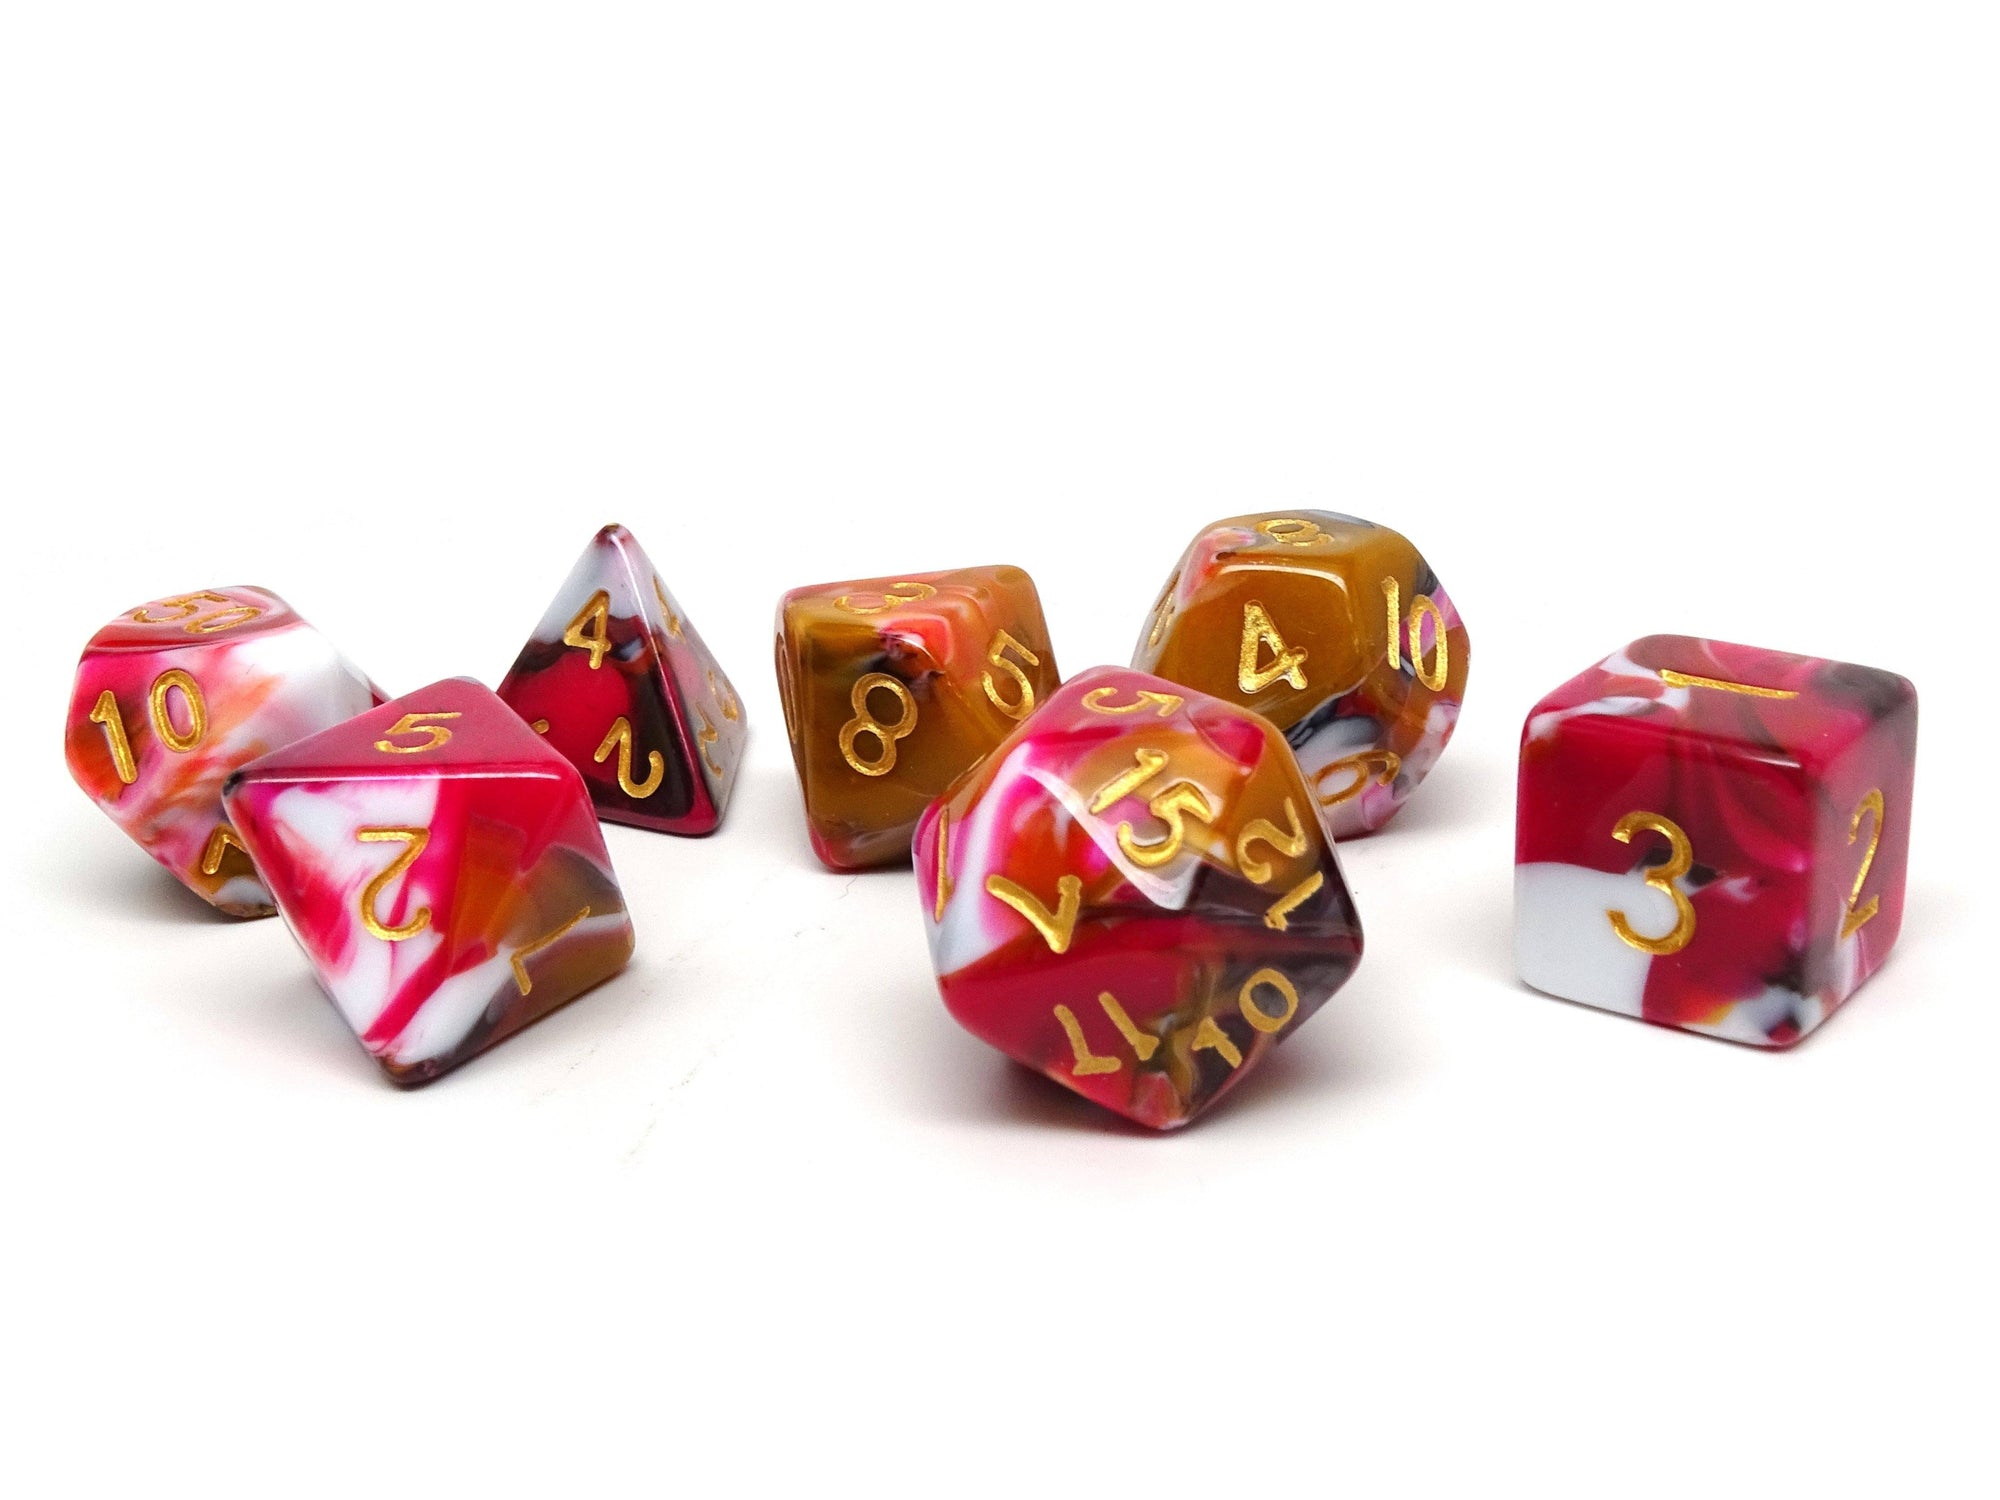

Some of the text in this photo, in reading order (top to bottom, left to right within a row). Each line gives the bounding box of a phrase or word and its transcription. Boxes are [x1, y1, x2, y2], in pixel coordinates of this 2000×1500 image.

[133, 590, 262, 634] 50
[564, 588, 612, 670] 4
[834, 581, 938, 615] 3
[1381, 575, 1448, 691] 10
[981, 628, 1040, 721] 5
[1238, 599, 1308, 694] 4
[1657, 668, 1800, 700] 1
[89, 667, 208, 785] 10
[374, 711, 463, 754] 5
[838, 672, 918, 777] 8
[1081, 687, 1185, 717] 5
[593, 716, 665, 799] 2
[1090, 748, 1215, 868] 15
[356, 826, 432, 942] 2
[1237, 797, 1324, 931] 12
[1605, 810, 1697, 955] 3
[1840, 787, 1885, 941] 2
[509, 905, 591, 996] 1
[985, 874, 1083, 955] 7
[1053, 991, 1160, 1076] 17
[1190, 967, 1300, 1069] 10
